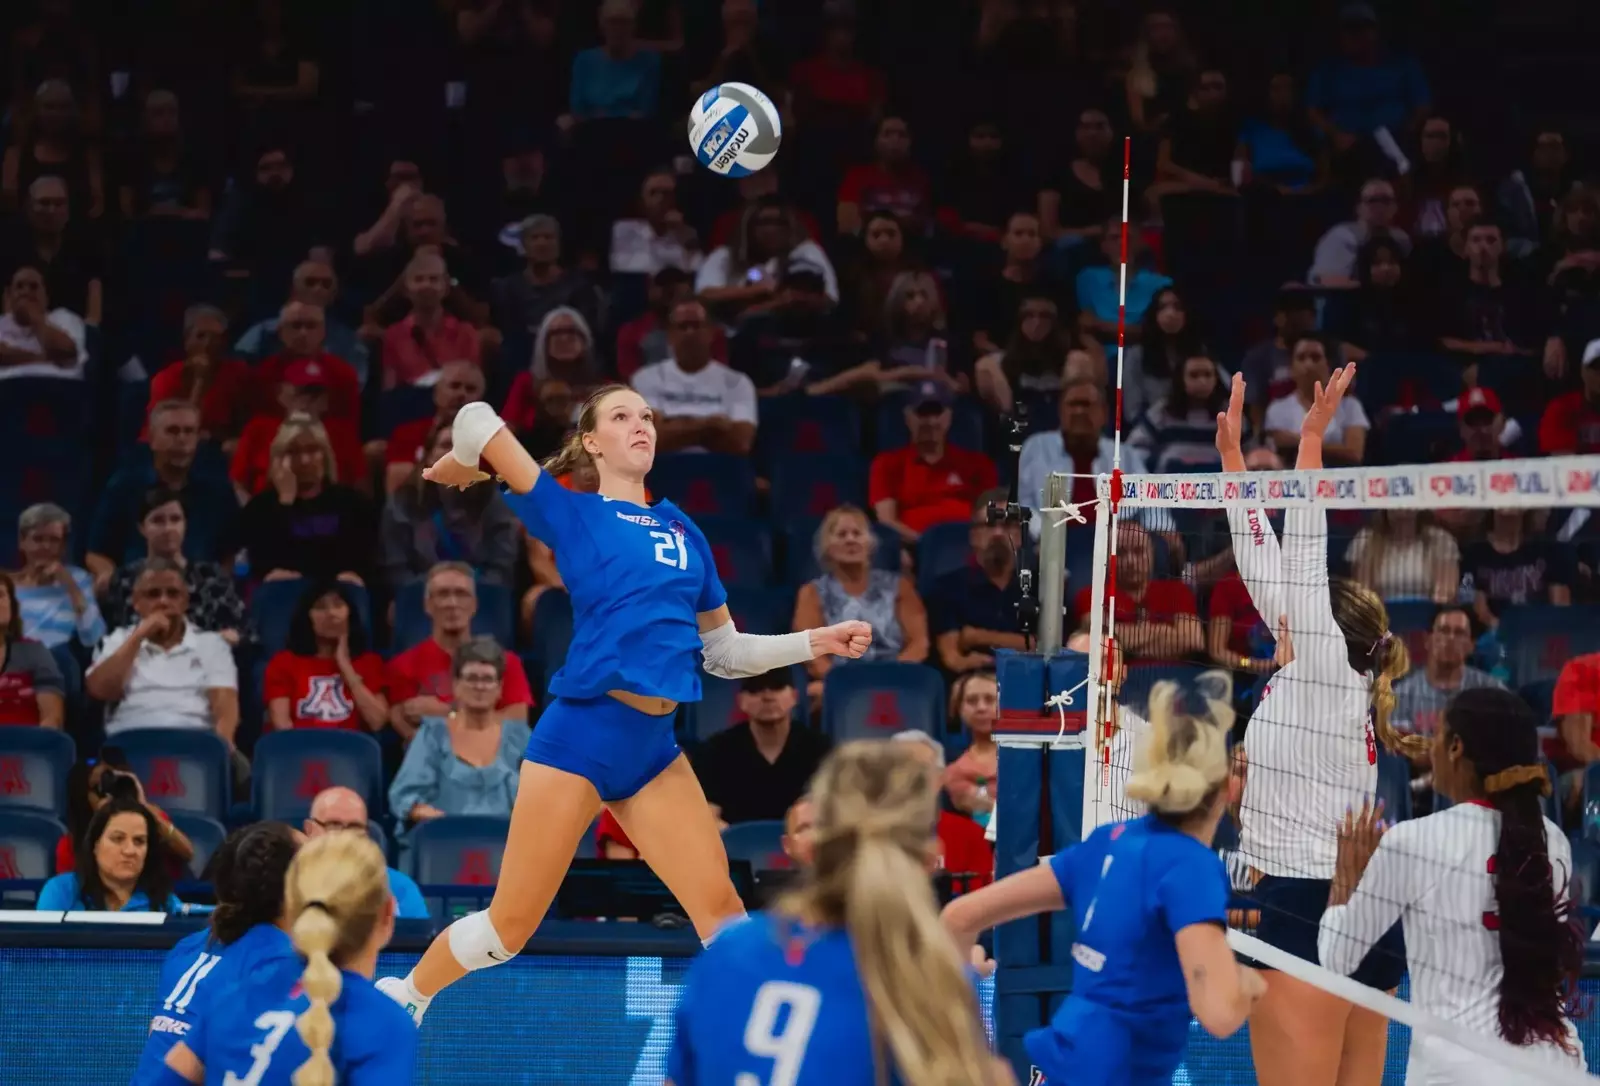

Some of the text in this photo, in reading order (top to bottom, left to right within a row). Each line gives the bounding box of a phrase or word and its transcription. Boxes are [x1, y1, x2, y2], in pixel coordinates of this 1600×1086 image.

[714, 128, 749, 170] molten
[649, 530, 688, 571] 21
[1248, 517, 1265, 547] DOWN
[296, 674, 354, 723] A
[163, 952, 222, 1015] 11
[222, 1009, 297, 1086] 3
[734, 979, 822, 1086] 9
